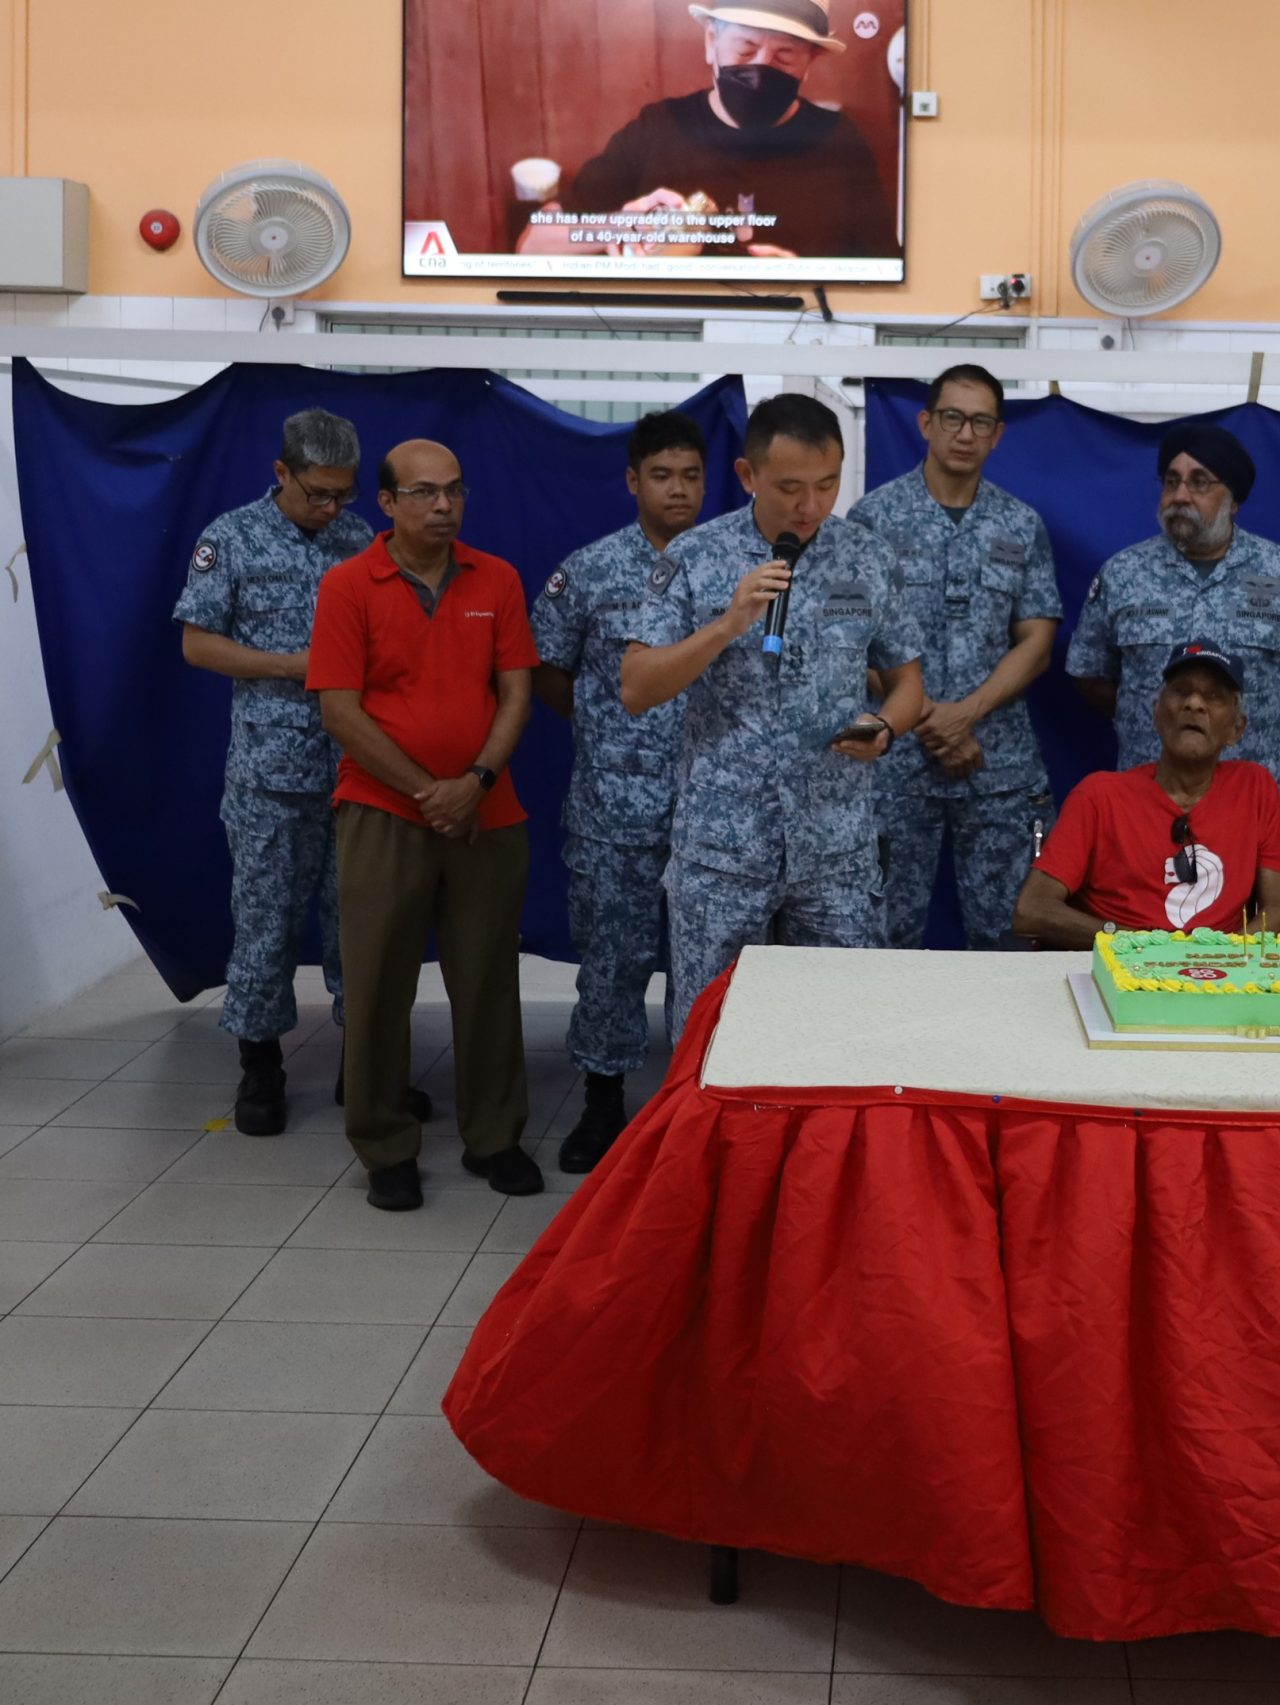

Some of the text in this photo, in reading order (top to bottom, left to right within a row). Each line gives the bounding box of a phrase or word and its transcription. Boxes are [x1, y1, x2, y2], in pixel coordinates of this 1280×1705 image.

[530, 211, 777, 229] she has now upgraded to the upper floor
[571, 230, 736, 245] of a 40-year-old warehouse
[419, 257, 446, 268] cna
[823, 608, 873, 618] SINGAPORE
[1236, 610, 1280, 622] SINGAPORE
